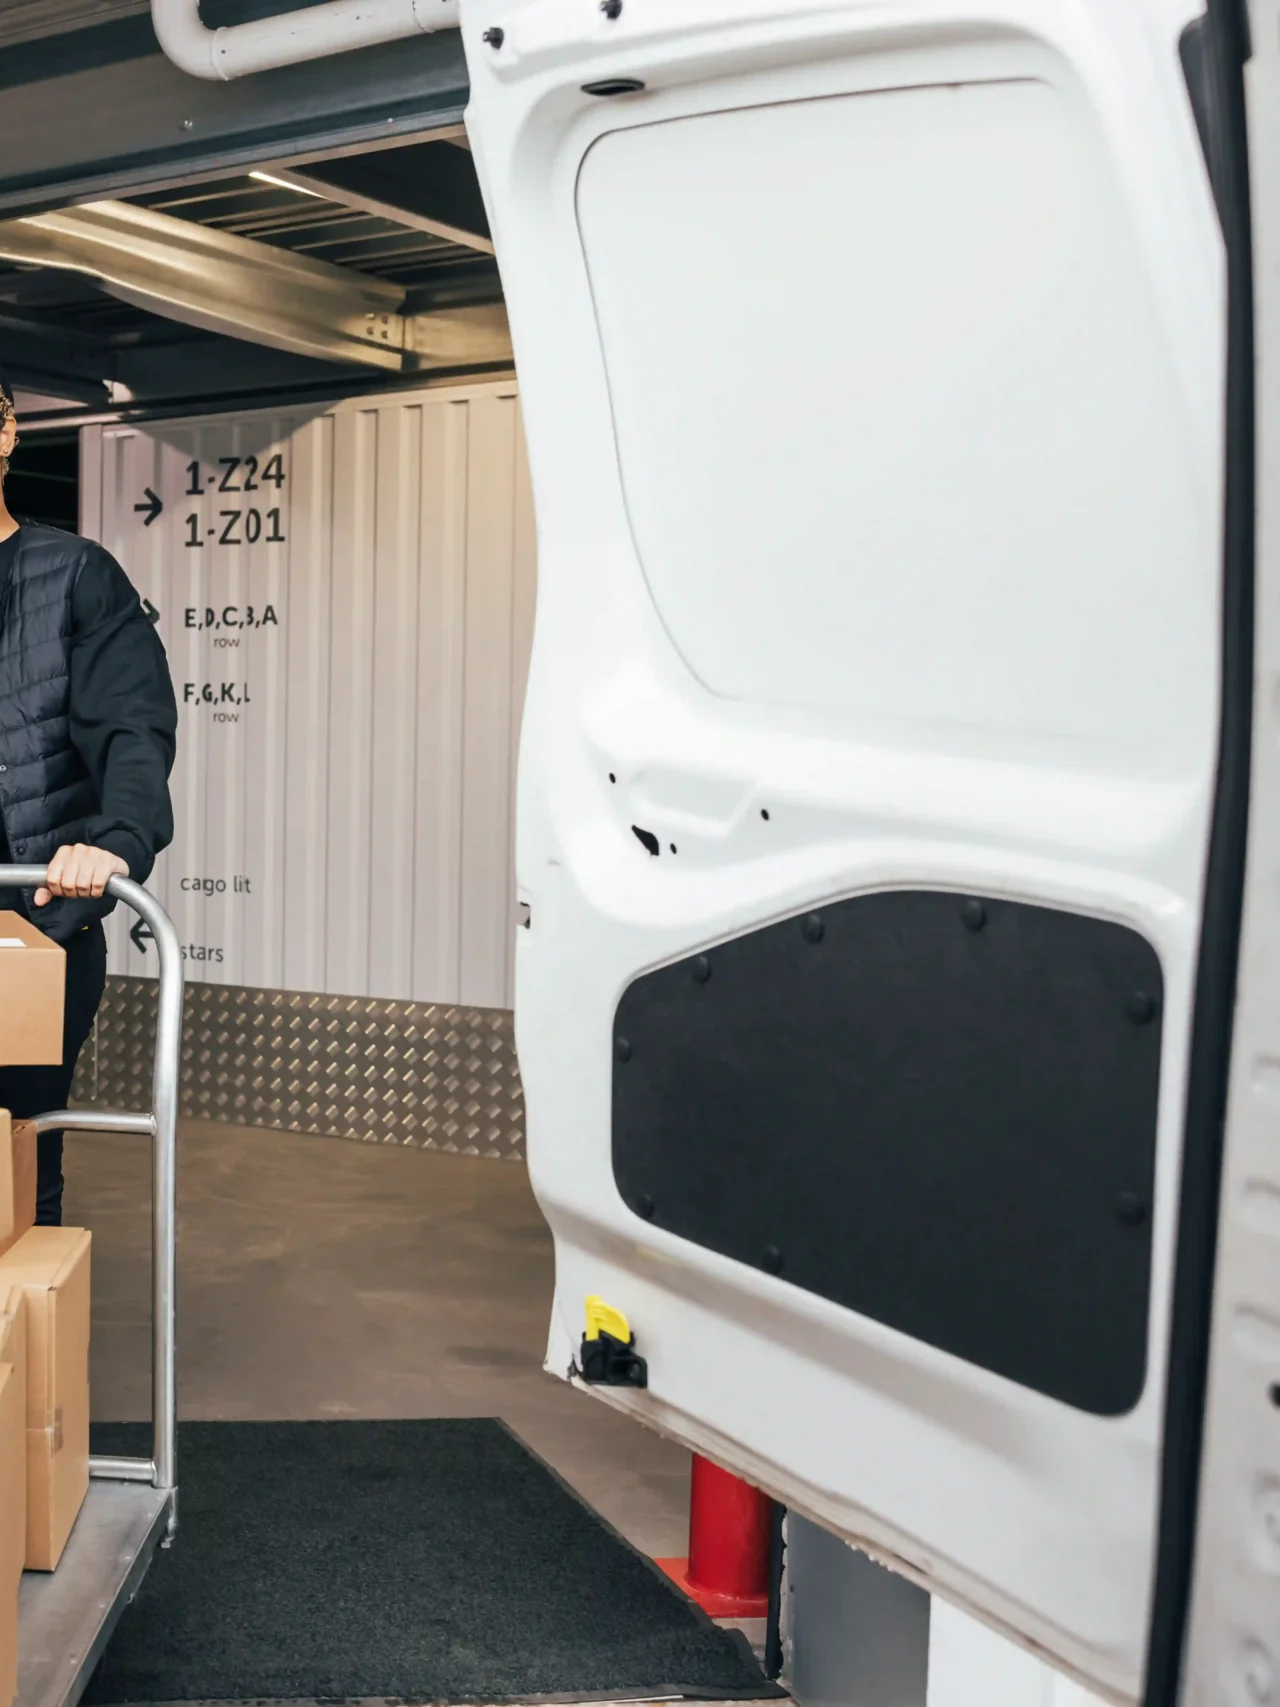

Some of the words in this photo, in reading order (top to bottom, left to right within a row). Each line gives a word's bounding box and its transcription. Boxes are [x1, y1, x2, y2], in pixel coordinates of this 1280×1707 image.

[185, 454, 285, 495] 1-Z24
[185, 507, 285, 547] 1-Z01
[214, 638, 240, 648] row
[213, 713, 239, 723] row
